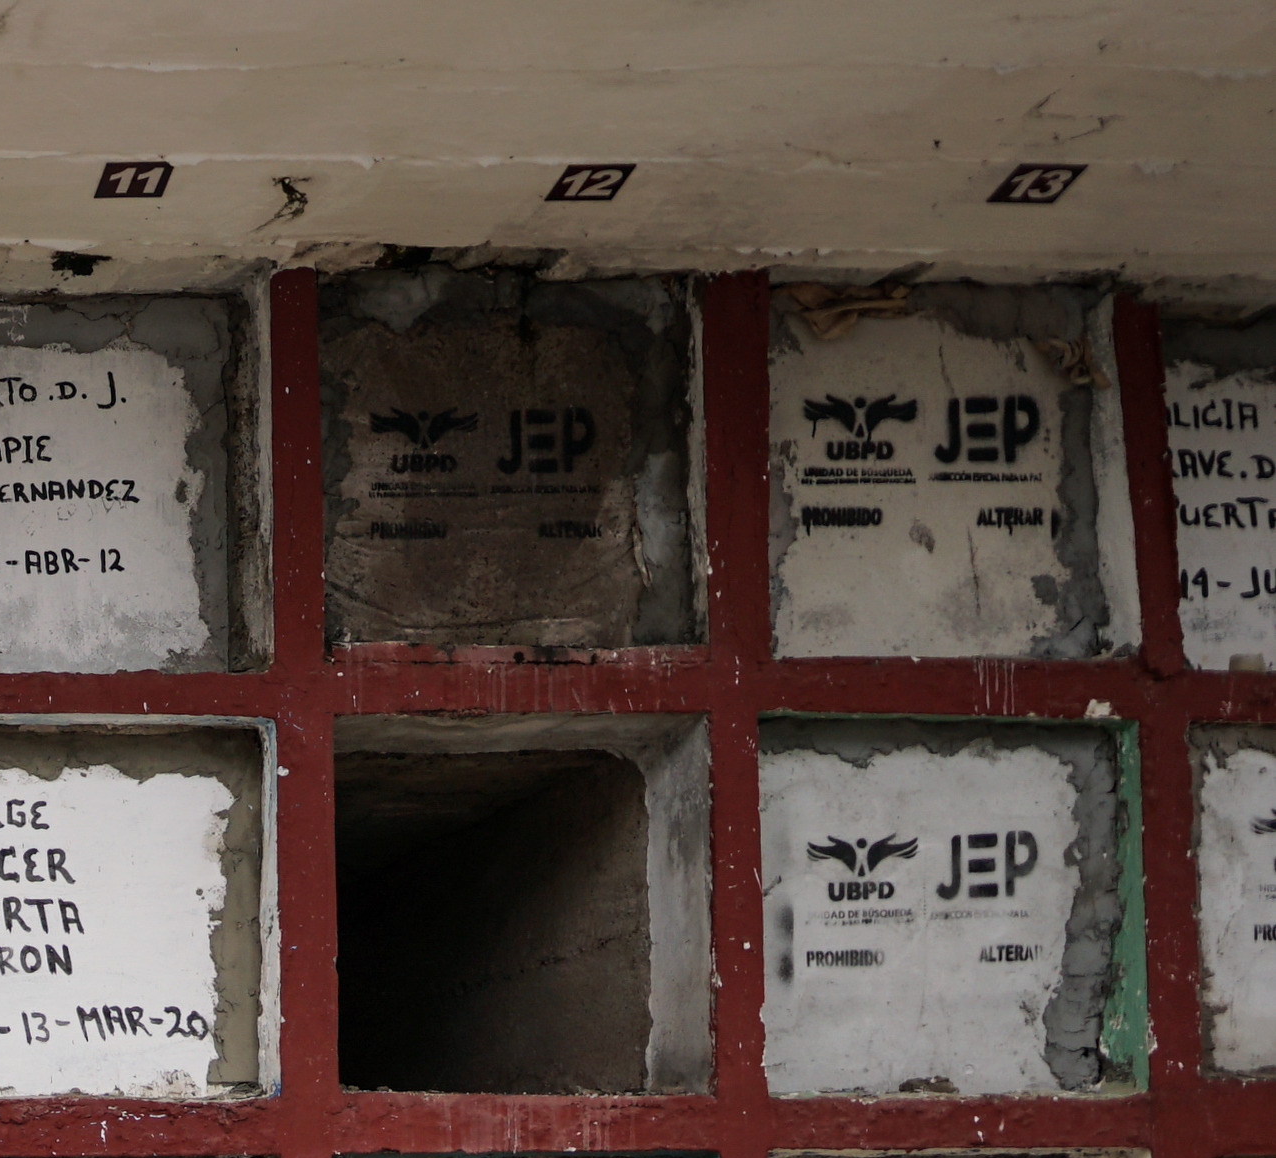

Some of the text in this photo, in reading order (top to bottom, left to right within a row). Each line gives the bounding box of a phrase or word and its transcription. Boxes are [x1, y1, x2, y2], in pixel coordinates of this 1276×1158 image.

[108, 168, 160, 194] 11
[561, 168, 623, 197] 12
[1009, 169, 1073, 199] 13
[497, 406, 596, 474] JEP
[934, 396, 1039, 463] JEP
[826, 440, 894, 460] UBPD
[801, 507, 882, 528] PROHIBIDO
[936, 830, 1038, 900] JEP
[828, 881, 895, 902] UBPD
[806, 949, 885, 968] PROHIBIDO
